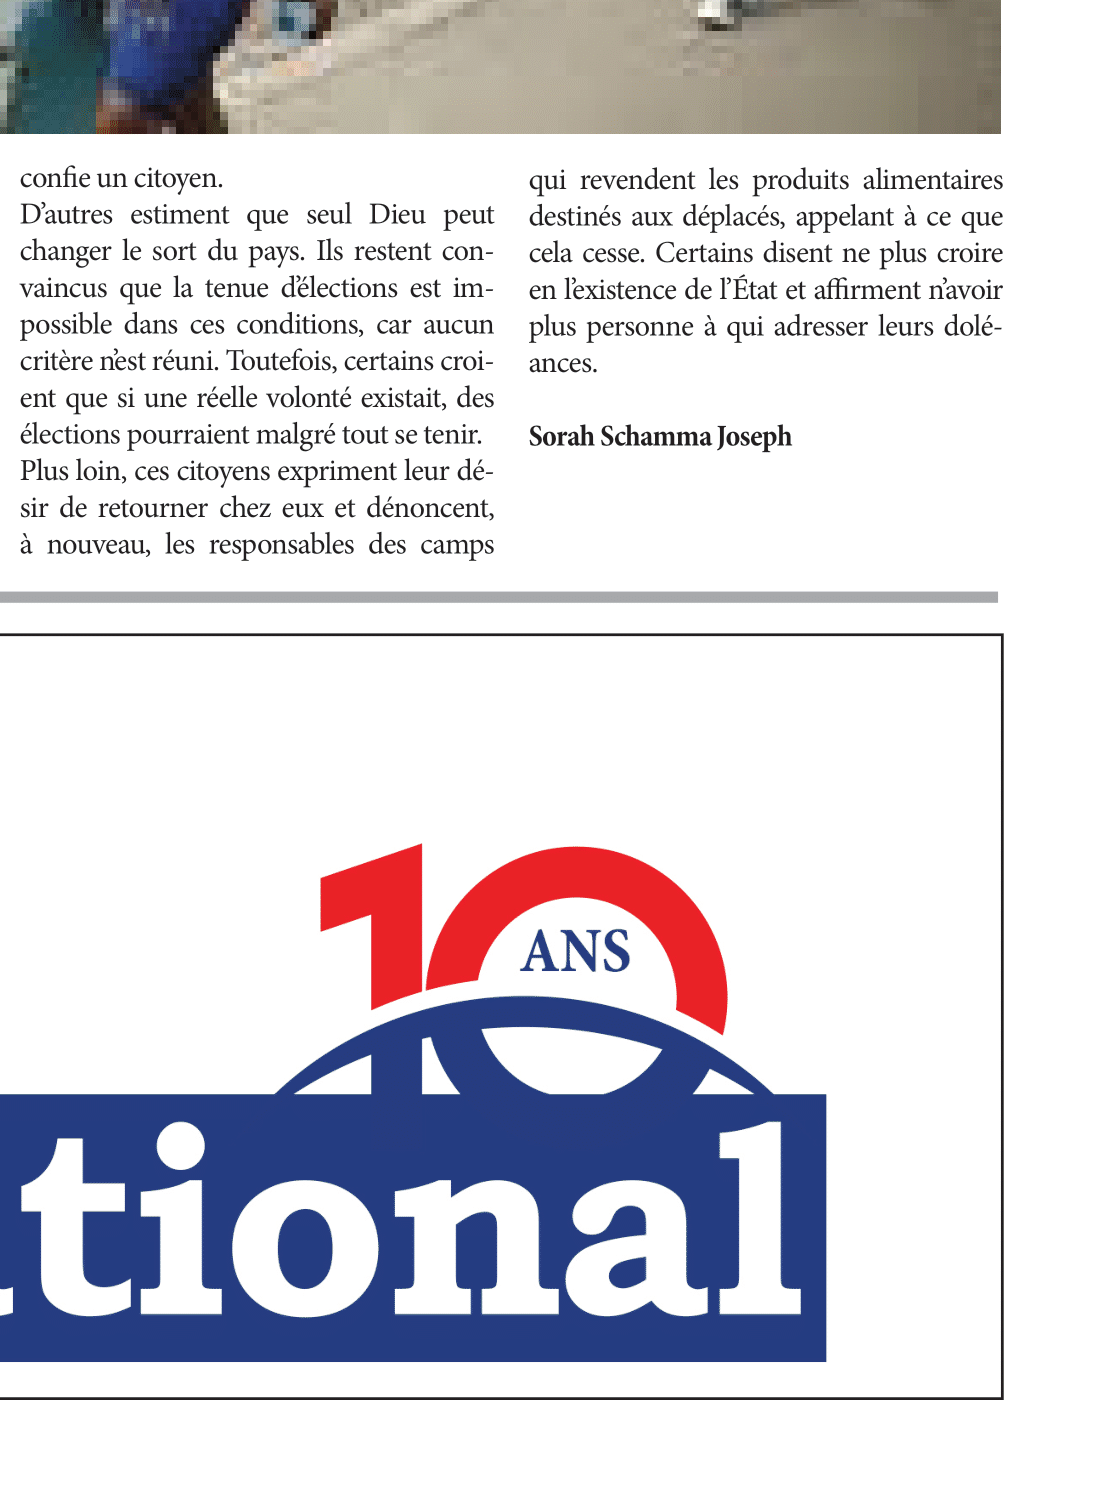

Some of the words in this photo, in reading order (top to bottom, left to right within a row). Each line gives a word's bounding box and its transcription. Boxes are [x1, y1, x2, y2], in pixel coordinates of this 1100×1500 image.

[20, 164, 91, 188] confie
[96, 172, 128, 188] un
[134, 167, 223, 196] citoyen.
[529, 169, 567, 197] qui
[580, 166, 696, 190] revendent
[708, 167, 739, 190] les
[752, 166, 850, 197] produits
[863, 167, 1004, 190] alimentaires
[20, 201, 113, 225] D’autres
[130, 203, 230, 225] estiment
[246, 209, 289, 232] que
[306, 201, 352, 225] seul
[369, 203, 427, 225] Dieu
[443, 205, 495, 232] peut
[529, 240, 574, 263] cela
[582, 247, 645, 263] cesse.
[655, 241, 754, 263] Certains
[763, 239, 833, 263] disent
[841, 247, 871, 263] ne
[879, 240, 927, 270] plus
[937, 242, 1004, 263] croire
[19, 277, 108, 298] vaincus
[119, 282, 162, 305] que
[173, 274, 194, 298] la
[204, 279, 269, 298] tenue
[281, 274, 398, 298] d’élections
[410, 279, 442, 298] est
[453, 277, 494, 298] im-
[529, 284, 557, 300] en
[564, 276, 677, 300] l’existence
[684, 276, 713, 300] de
[719, 273, 778, 300] l’État
[785, 281, 807, 300] et
[814, 276, 922, 300] affirment
[928, 276, 1004, 300] n’avoir
[20, 349, 94, 371] critère
[99, 347, 147, 371] n’est
[152, 349, 219, 371] réuni.
[225, 347, 338, 374] Toutefois,
[344, 350, 434, 371] certains
[440, 350, 494, 371] croi-
[529, 357, 598, 373] ances.
[20, 421, 121, 445] élections
[126, 423, 250, 452] pourraient
[256, 421, 336, 452] malgré
[342, 425, 389, 445] tout
[394, 429, 418, 445] se
[423, 423, 482, 445] tenir.
[529, 423, 595, 447] Sorah
[600, 423, 713, 447] Schamma
[716, 423, 793, 453] Joseph
[20, 497, 49, 518] sir
[59, 494, 88, 518] de
[98, 499, 209, 518] retourner
[219, 494, 272, 518] chez
[282, 502, 325, 518] eux
[334, 499, 356, 518] et
[366, 494, 495, 521] dénoncent,
[519, 928, 631, 973] ANS
